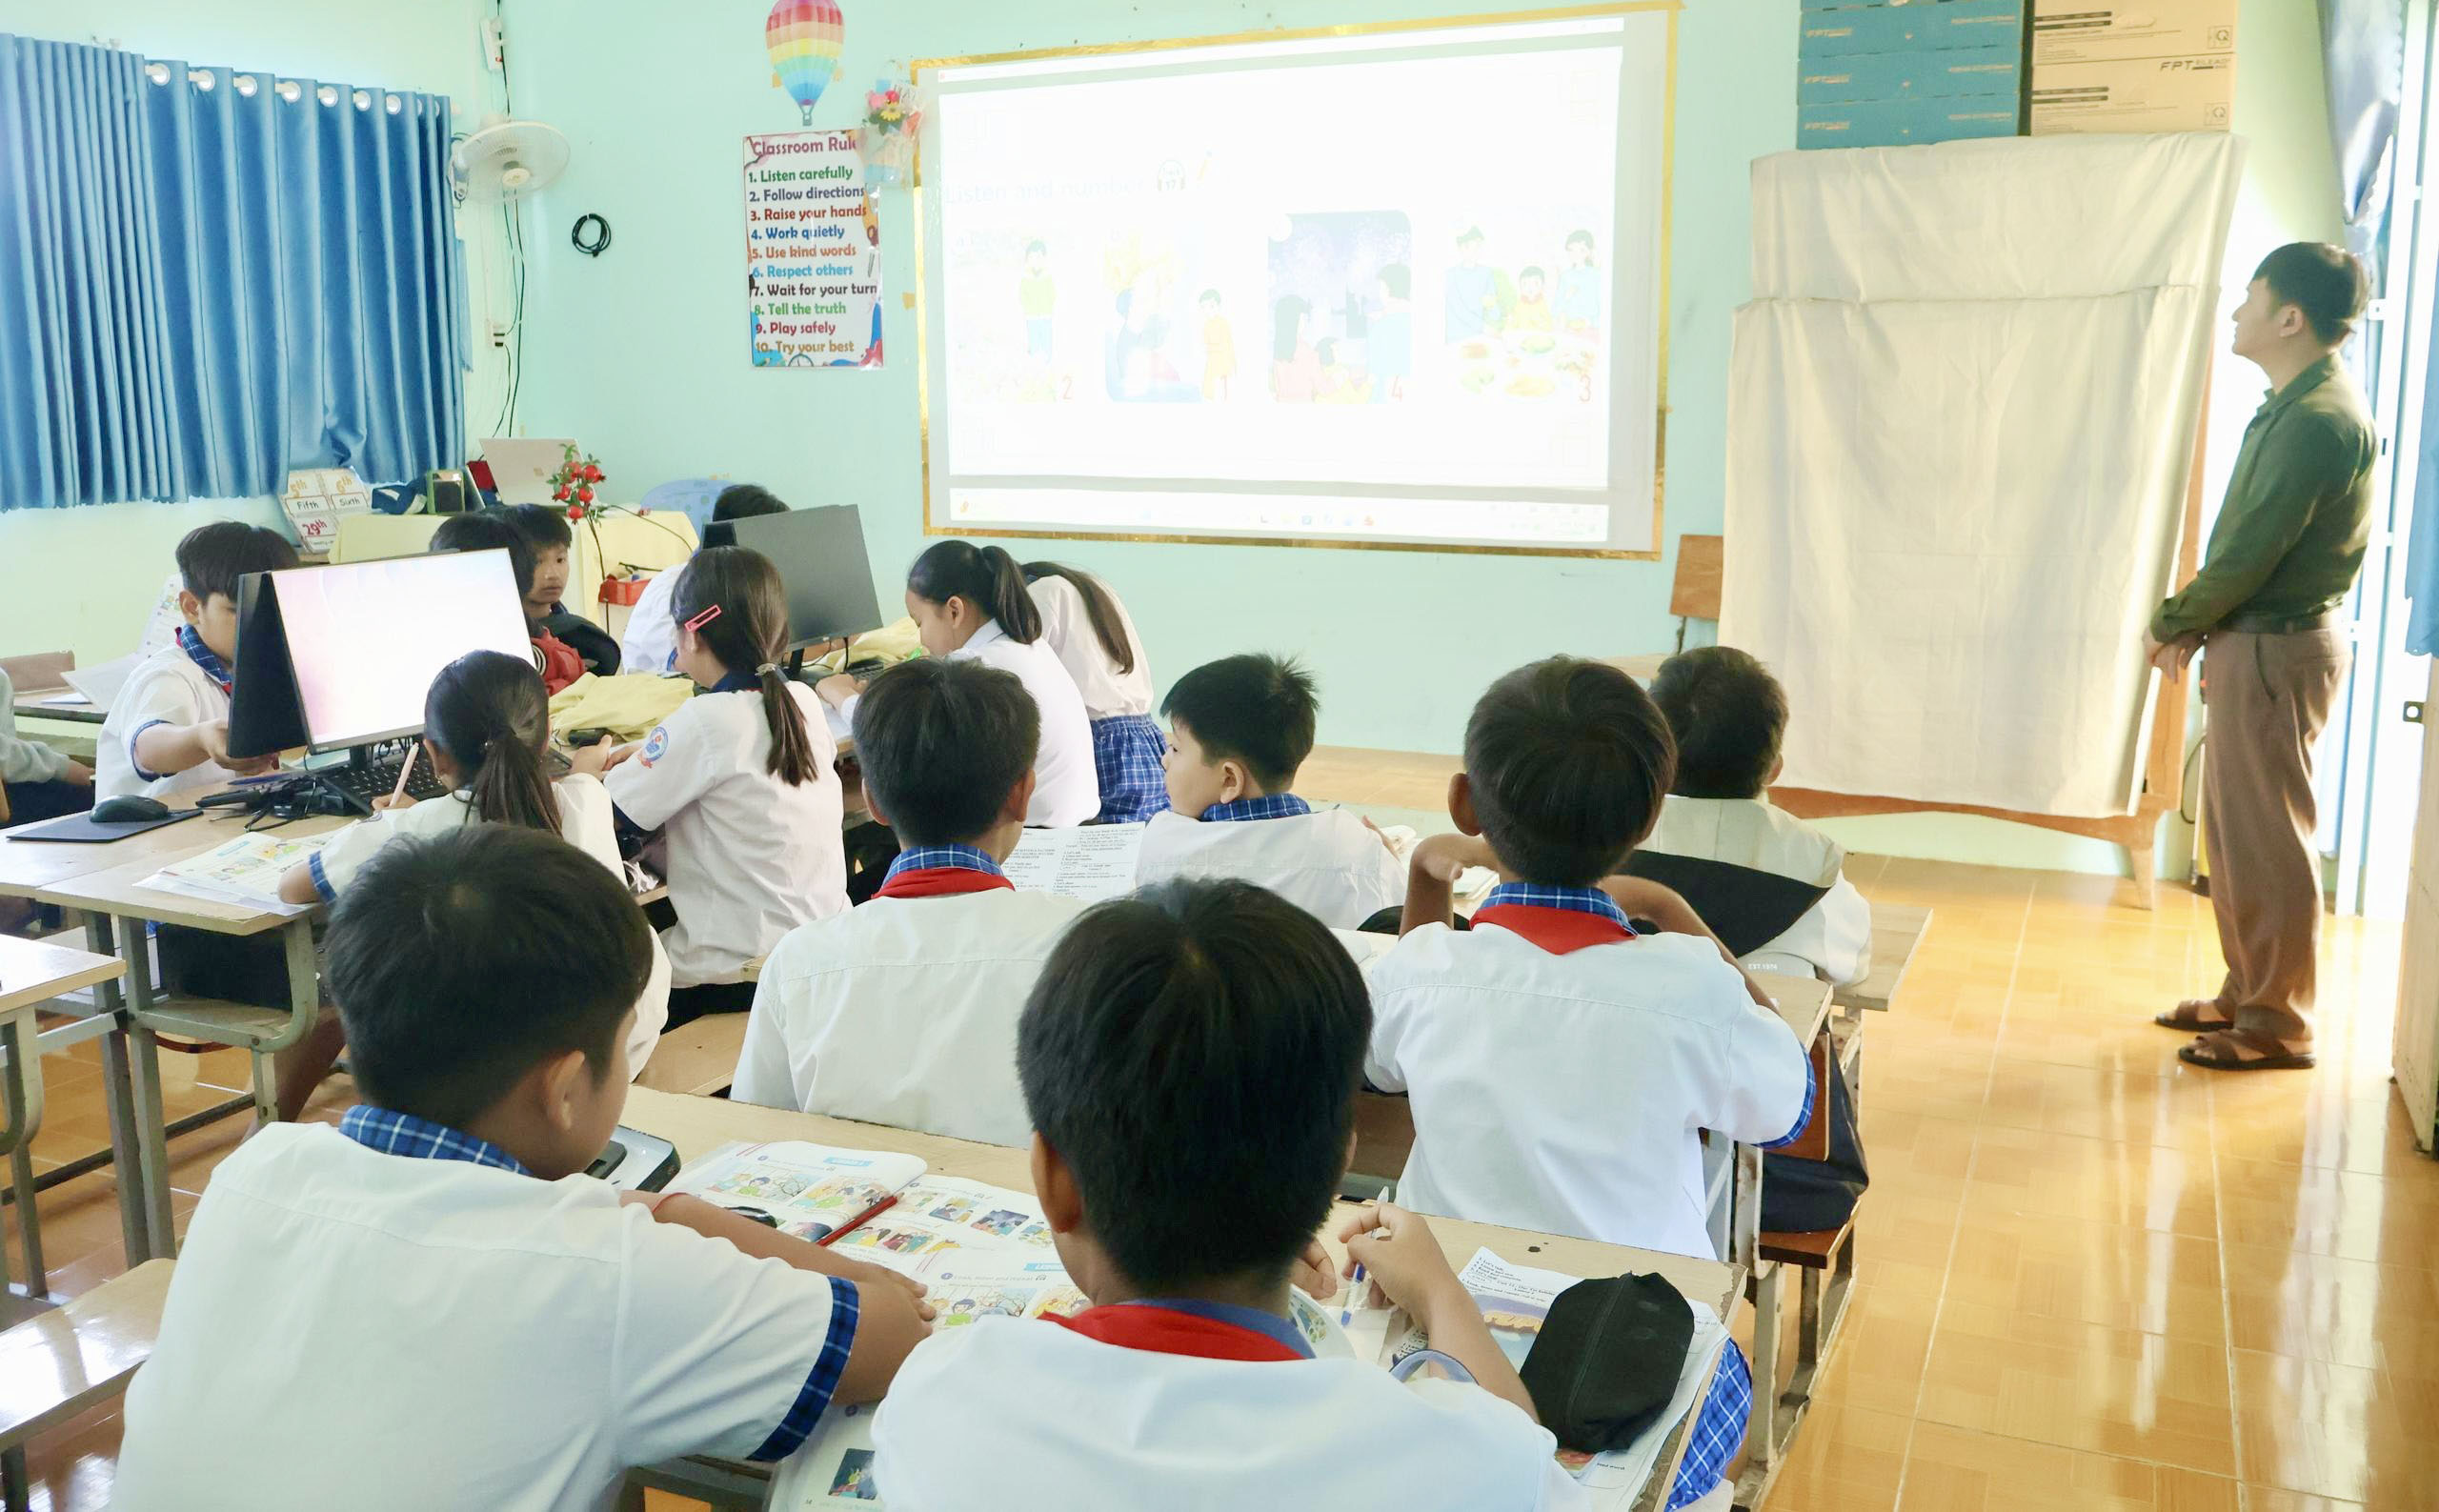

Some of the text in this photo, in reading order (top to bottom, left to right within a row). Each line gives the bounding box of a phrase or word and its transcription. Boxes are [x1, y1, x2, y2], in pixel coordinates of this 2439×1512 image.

[754, 140, 823, 156] Classroom
[748, 166, 853, 183] 1. Listen carefully
[749, 186, 864, 202] 2. Follow directions
[751, 204, 867, 221] 3. Raise your hands
[751, 224, 845, 240] 4. Work quietly
[752, 243, 857, 259] 5. Use kind words
[752, 263, 854, 279] 6. Respect others
[754, 283, 877, 297] 7. Wait for your turn
[754, 301, 846, 315] 8. Tell the truth
[756, 320, 836, 335] 9. Play safely
[776, 340, 795, 354] Try
[798, 343, 825, 354] your
[829, 340, 855, 353] best
[1061, 374, 1074, 401] 2
[1390, 373, 1403, 402] 4
[1579, 373, 1593, 402] 3
[290, 479, 306, 498] 5th
[336, 475, 352, 495] 6th
[296, 500, 319, 511] Fifth
[339, 497, 361, 507] Sixth
[301, 518, 328, 535] 29th
